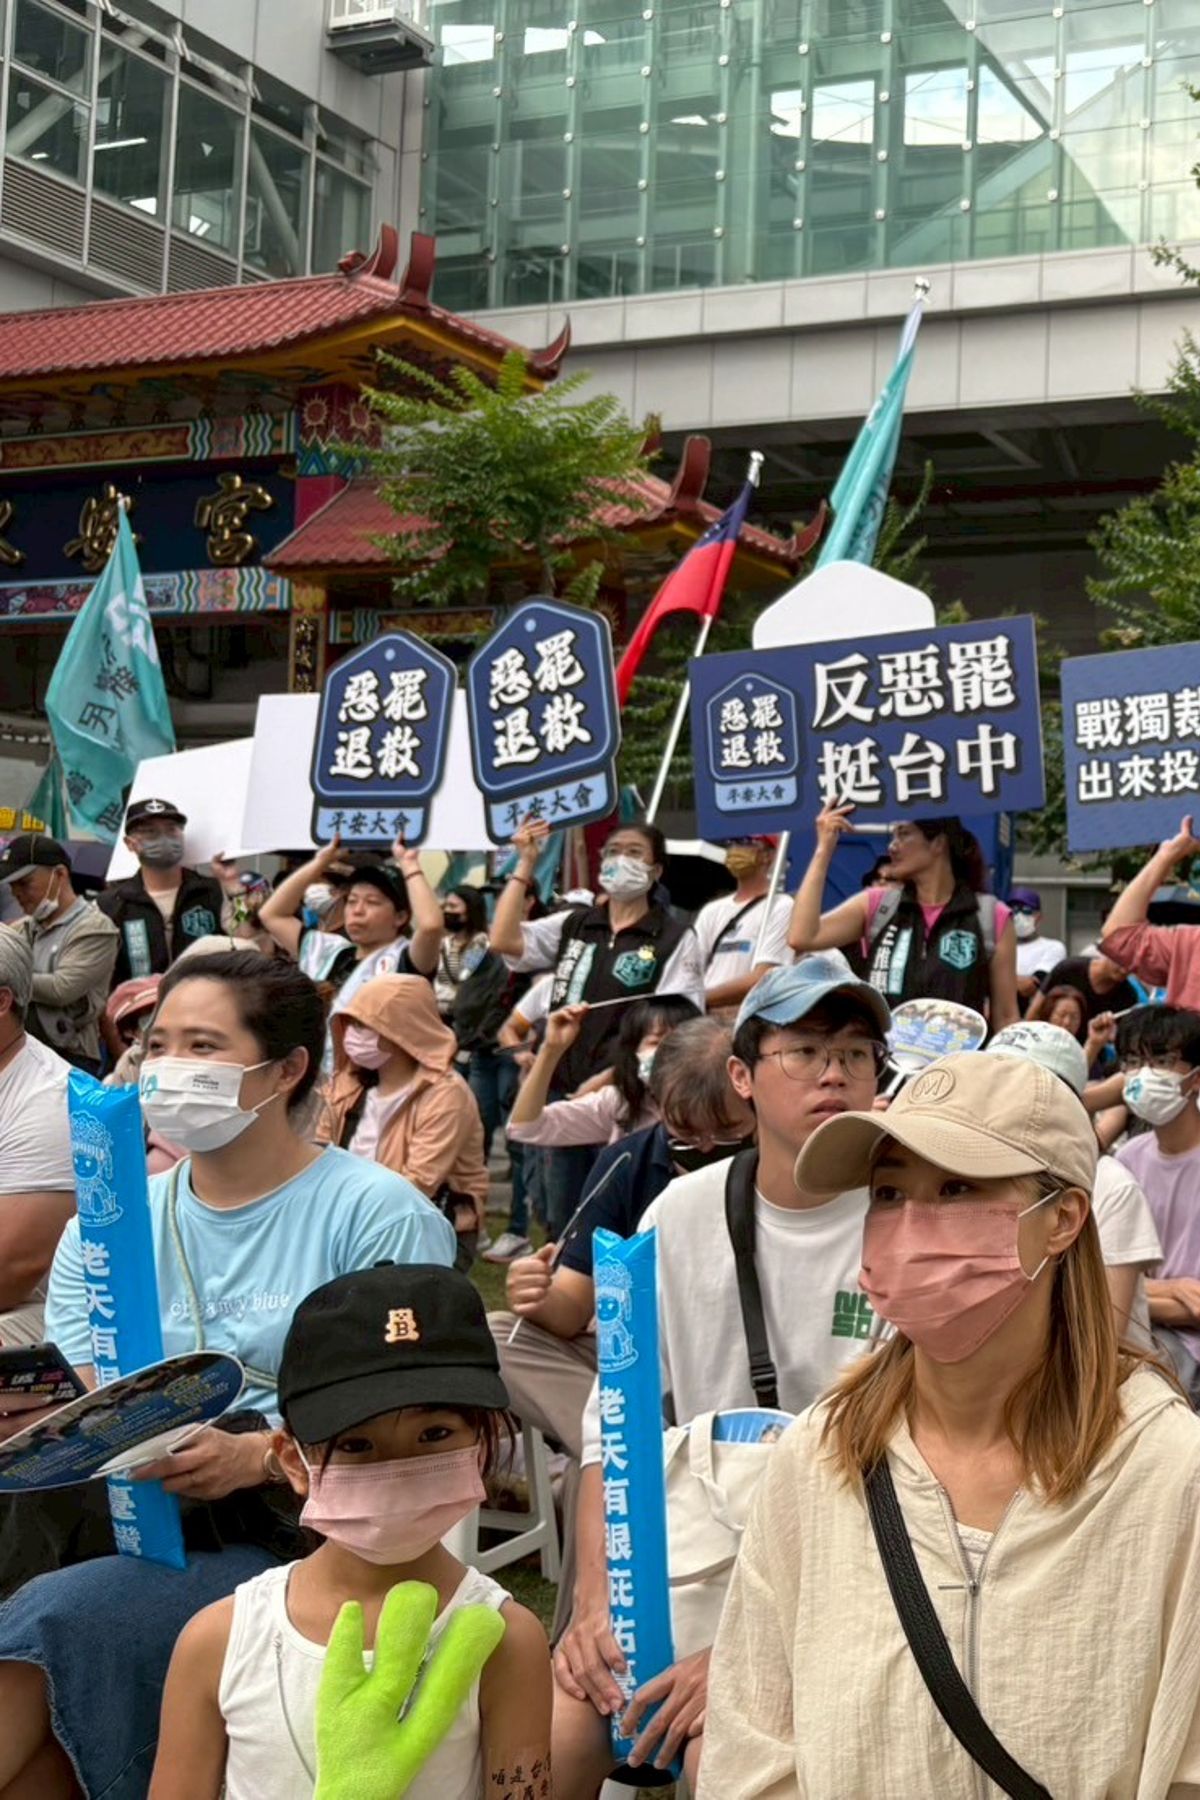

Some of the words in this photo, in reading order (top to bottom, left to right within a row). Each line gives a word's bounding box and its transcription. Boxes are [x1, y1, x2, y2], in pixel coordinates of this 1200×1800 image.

[337, 668, 428, 723] 惡罷
[488, 628, 585, 711] 惡罷
[811, 634, 1017, 729] 反惡罷
[492, 692, 592, 768] 退散
[718, 691, 783, 733] 惡罷
[329, 725, 421, 779] 退散
[720, 729, 786, 769] 退散
[817, 722, 1019, 806] 挺台中
[503, 782, 594, 827] 平安大會
[725, 785, 787, 806] 平安大會
[328, 810, 411, 836] 平安大會
